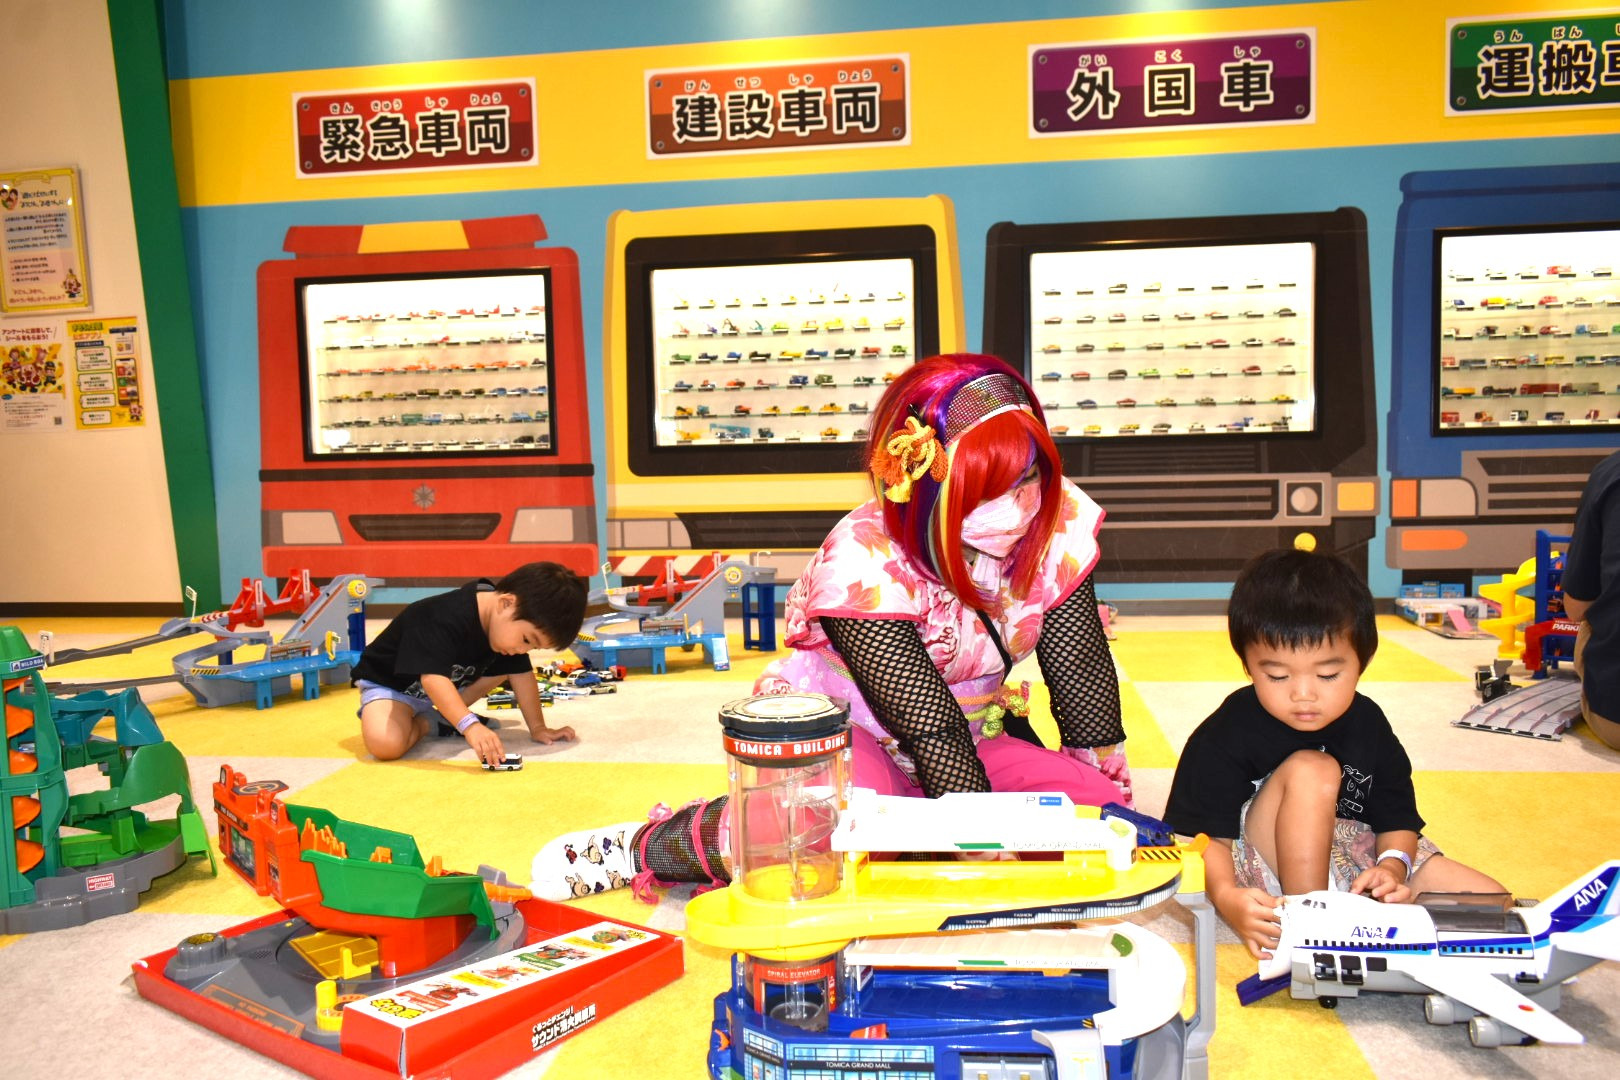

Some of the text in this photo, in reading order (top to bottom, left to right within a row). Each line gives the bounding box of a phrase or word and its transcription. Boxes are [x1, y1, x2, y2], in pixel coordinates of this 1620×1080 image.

[1067, 59, 1273, 120] 外国車
[673, 82, 880, 143] 建設車両
[320, 106, 510, 163] 緊急車両
[734, 735, 845, 755] TOMICA BUILDING
[1572, 878, 1608, 911] ANA
[1351, 926, 1383, 938] ANA
[767, 968, 820, 978] SPIRAL ELEVATOR
